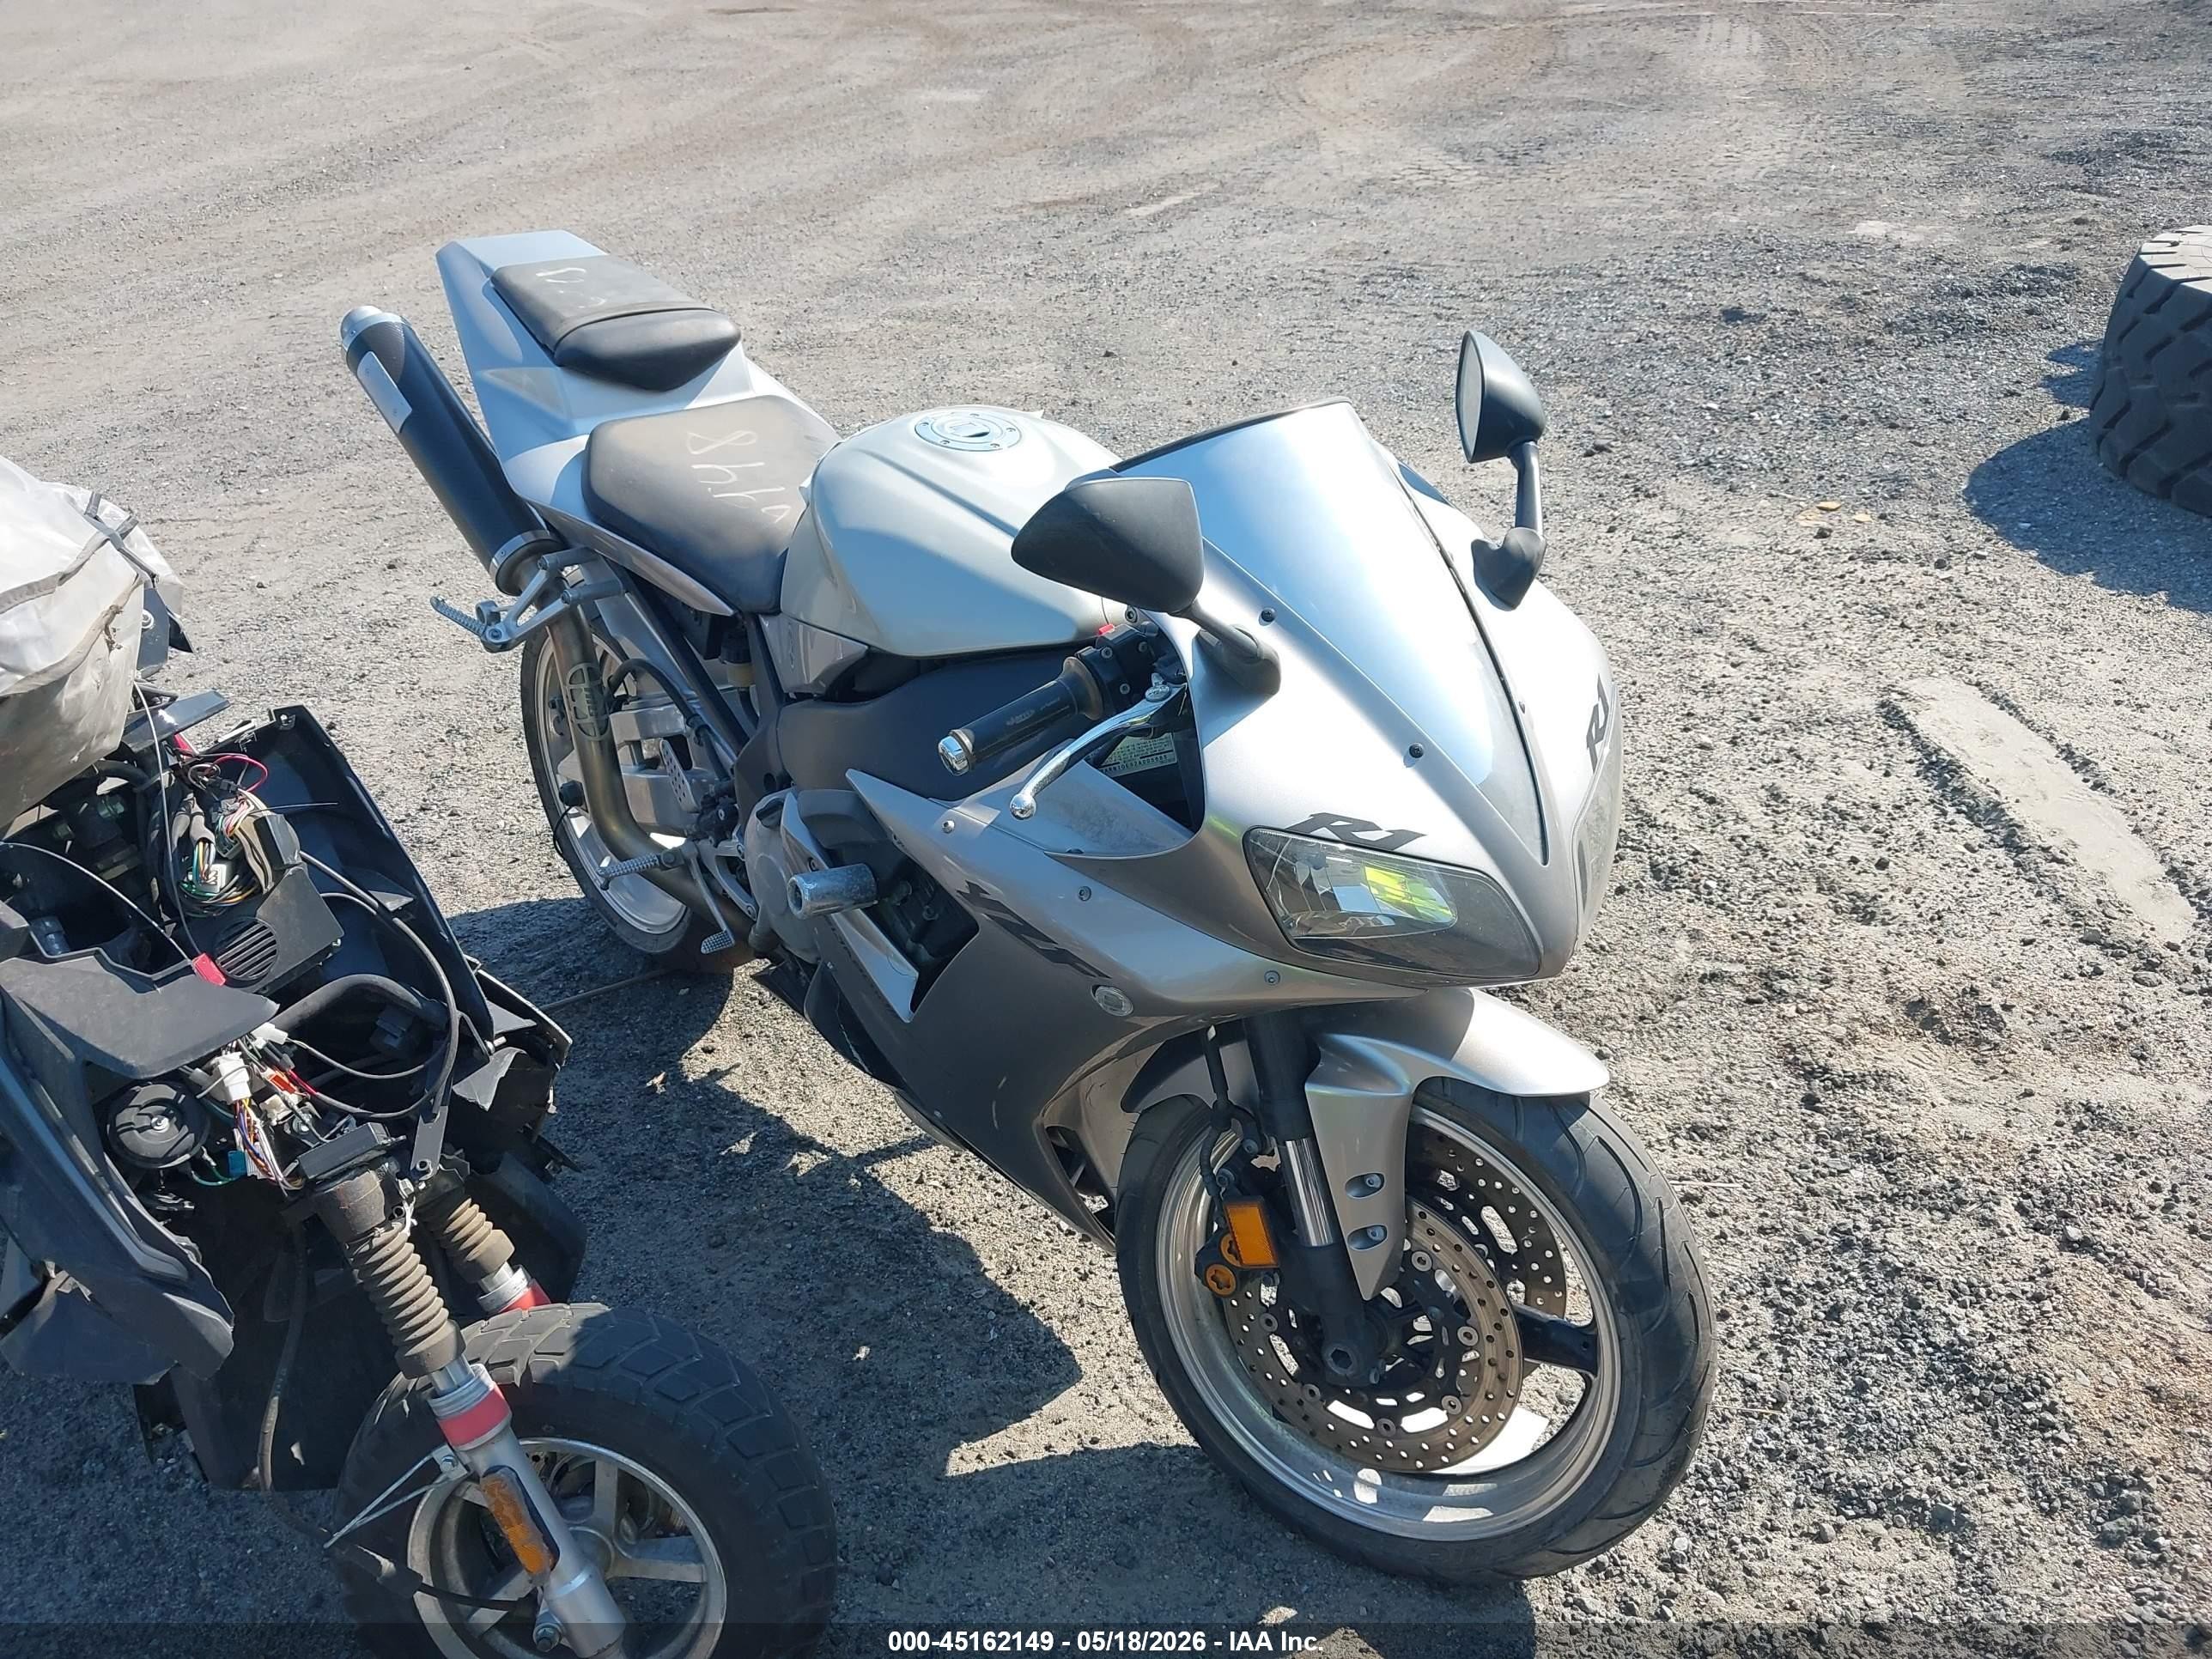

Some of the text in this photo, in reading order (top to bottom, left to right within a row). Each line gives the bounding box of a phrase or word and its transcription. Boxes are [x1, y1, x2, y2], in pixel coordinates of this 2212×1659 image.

[1585, 673, 1610, 775] R1
[1285, 811, 1428, 852] R1
[956, 878, 1113, 980] YZF
